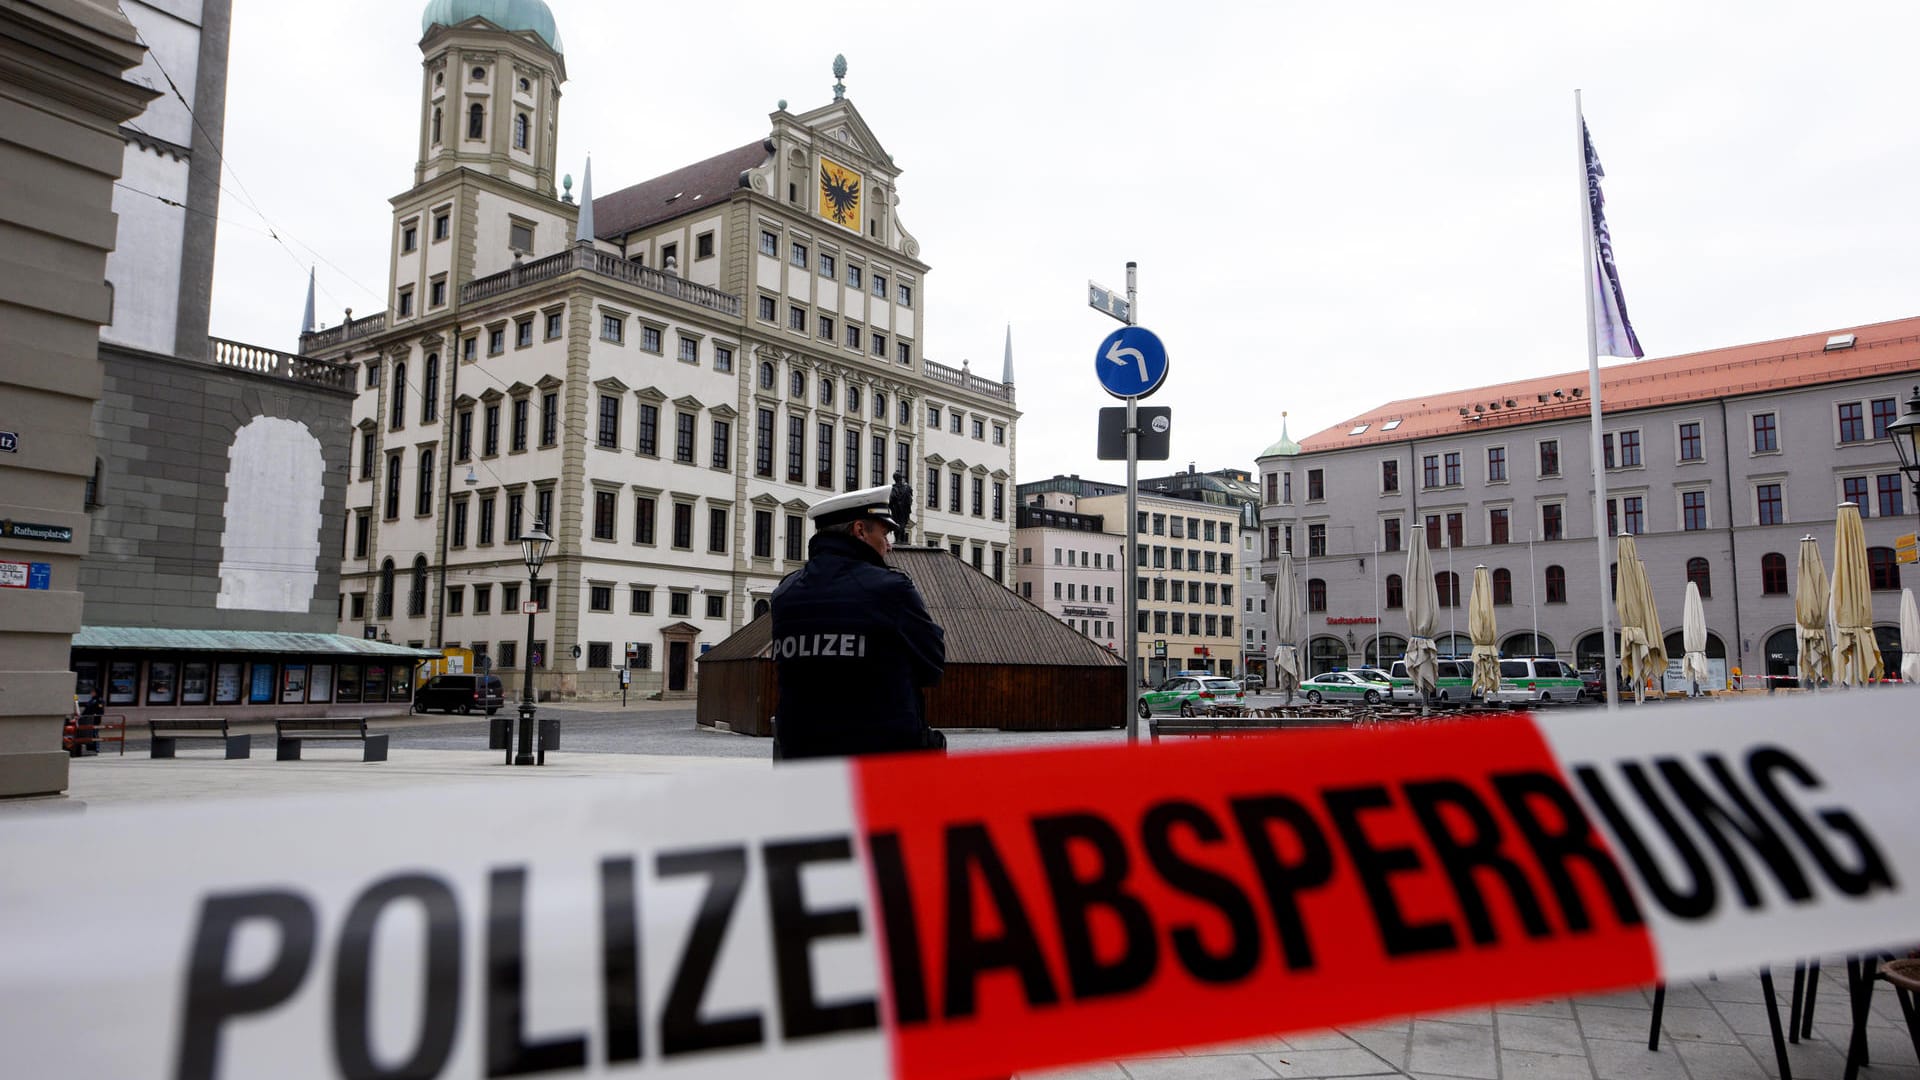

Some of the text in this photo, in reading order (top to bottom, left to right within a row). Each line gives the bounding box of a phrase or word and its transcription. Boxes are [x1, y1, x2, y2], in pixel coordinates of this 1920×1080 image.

[13, 526, 62, 539] Rathausplatz
[772, 634, 866, 661] POLIZEI
[172, 743, 1899, 1080] POLIZEIABSPERRUNG
